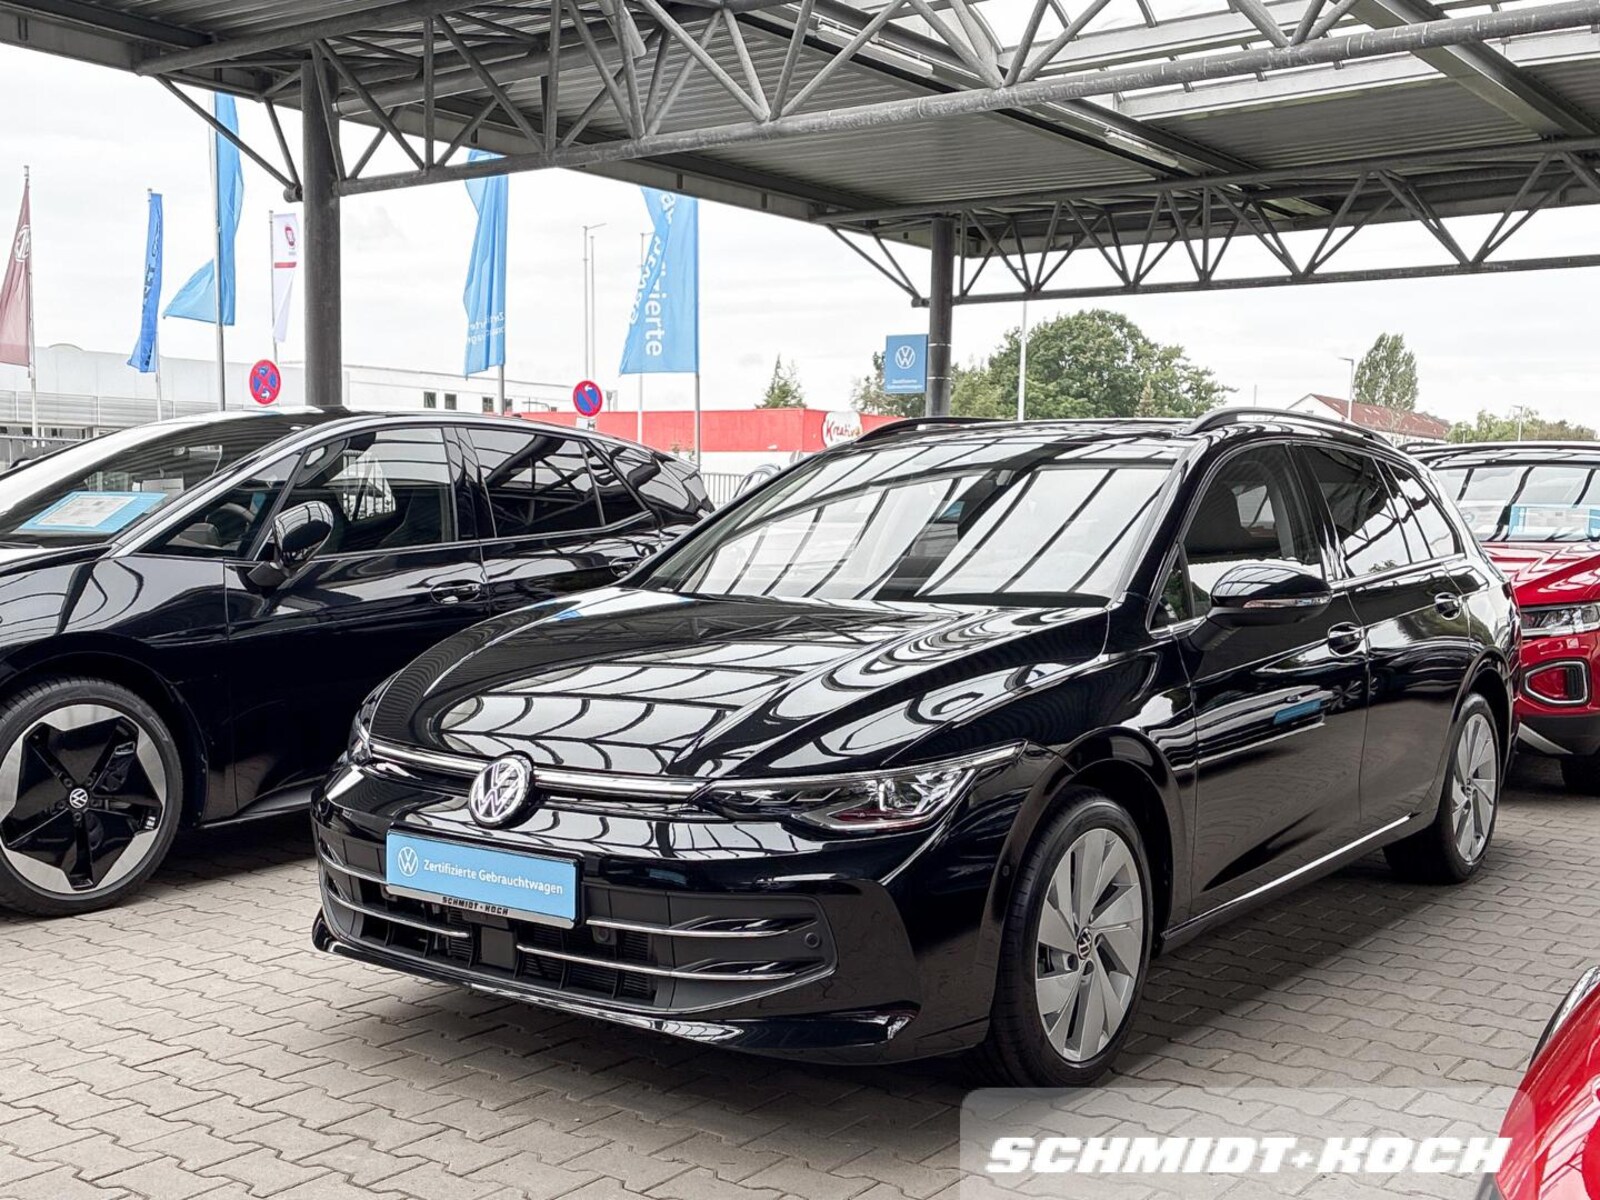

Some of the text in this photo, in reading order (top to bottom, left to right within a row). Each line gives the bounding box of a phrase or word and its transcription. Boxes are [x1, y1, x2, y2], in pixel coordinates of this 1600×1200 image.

[470, 757, 526, 823] VW
[398, 846, 563, 895] VW Zertifizierte Gebrauchtwagen
[441, 896, 479, 910] SCHMIDT
[484, 904, 509, 916] KOCH
